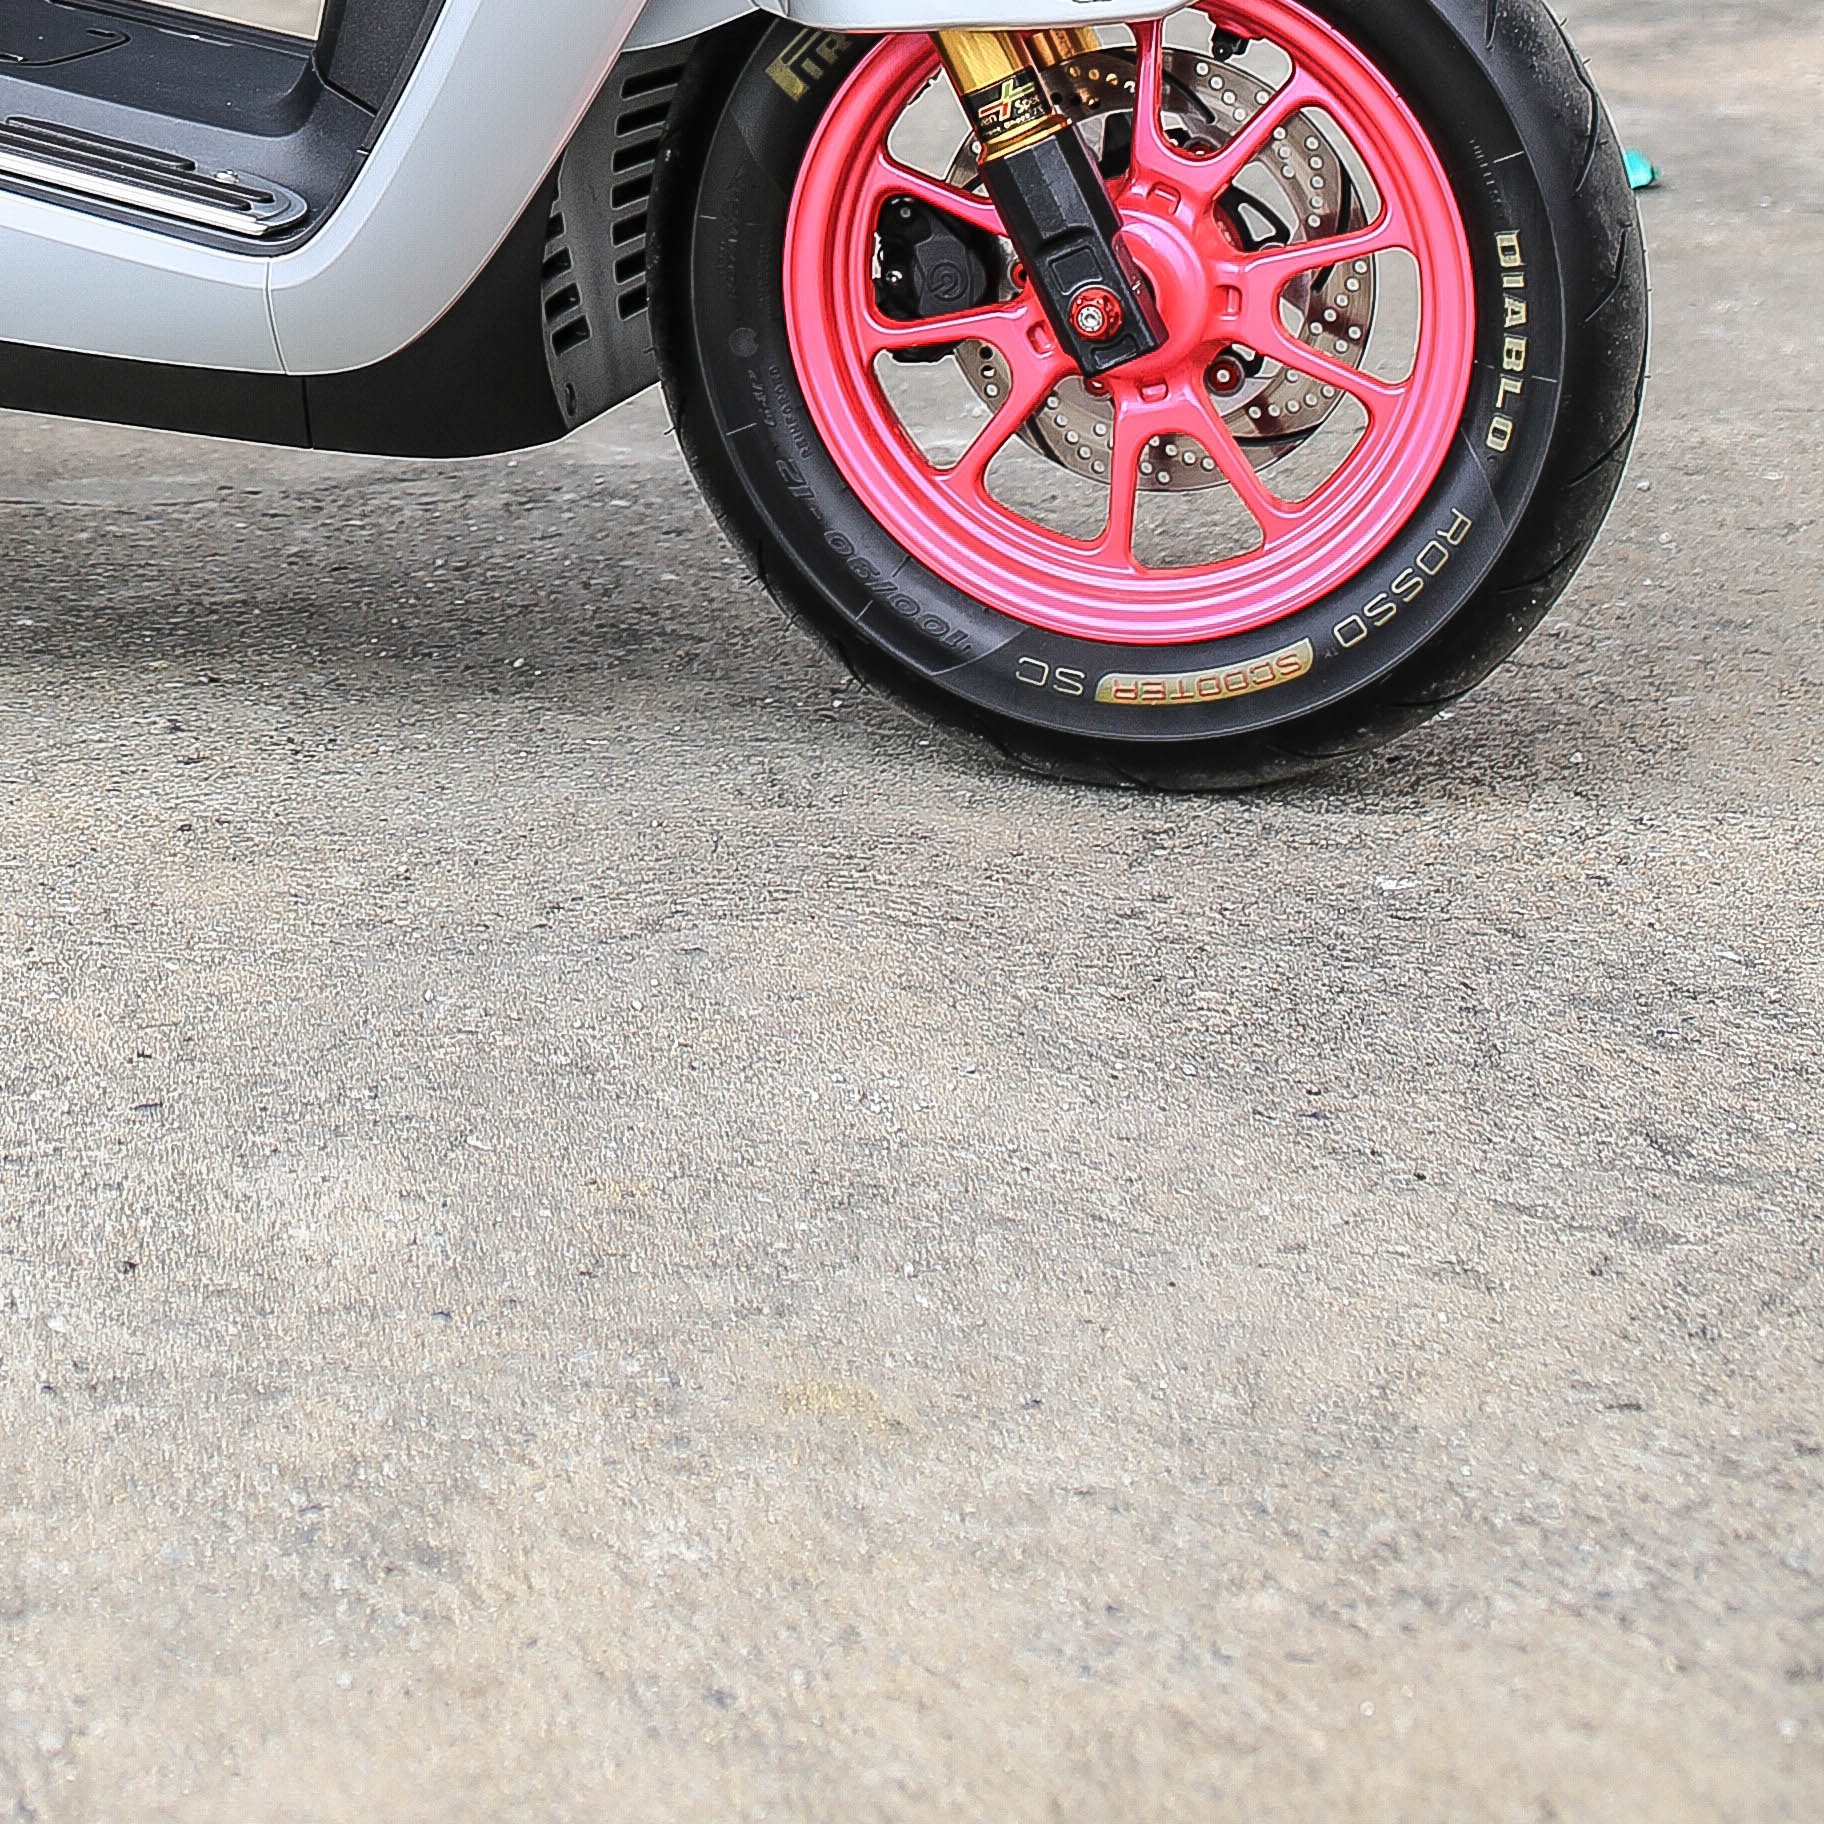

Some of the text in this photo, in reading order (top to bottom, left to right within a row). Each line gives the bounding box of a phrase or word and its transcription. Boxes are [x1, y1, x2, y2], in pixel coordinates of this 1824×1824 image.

[1015, 229, 1527, 702] DIABLO ROSSO SCOOTER SC
